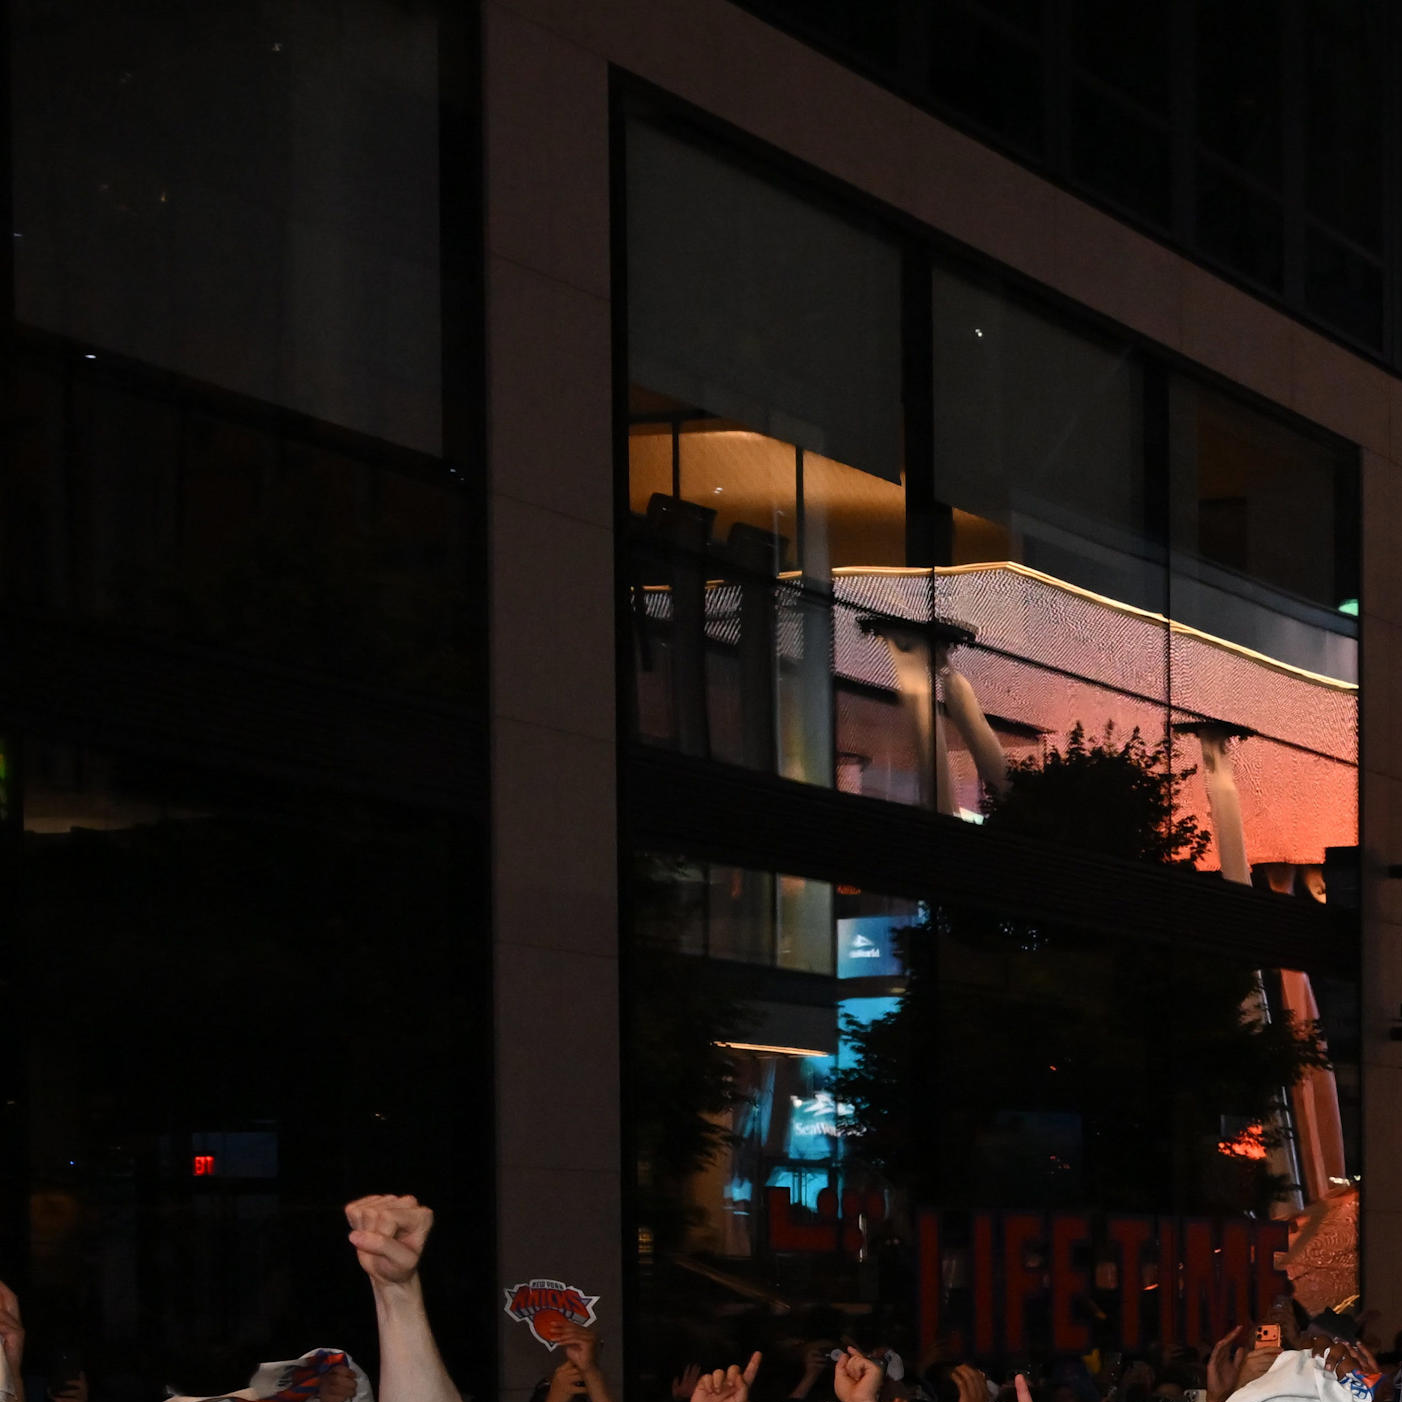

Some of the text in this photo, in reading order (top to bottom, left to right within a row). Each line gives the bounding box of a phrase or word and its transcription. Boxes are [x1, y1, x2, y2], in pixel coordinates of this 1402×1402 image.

[510, 1286, 590, 1320] KNICKS
[919, 1208, 1091, 1356] LIFE
[1109, 1211, 1291, 1352] TIME
